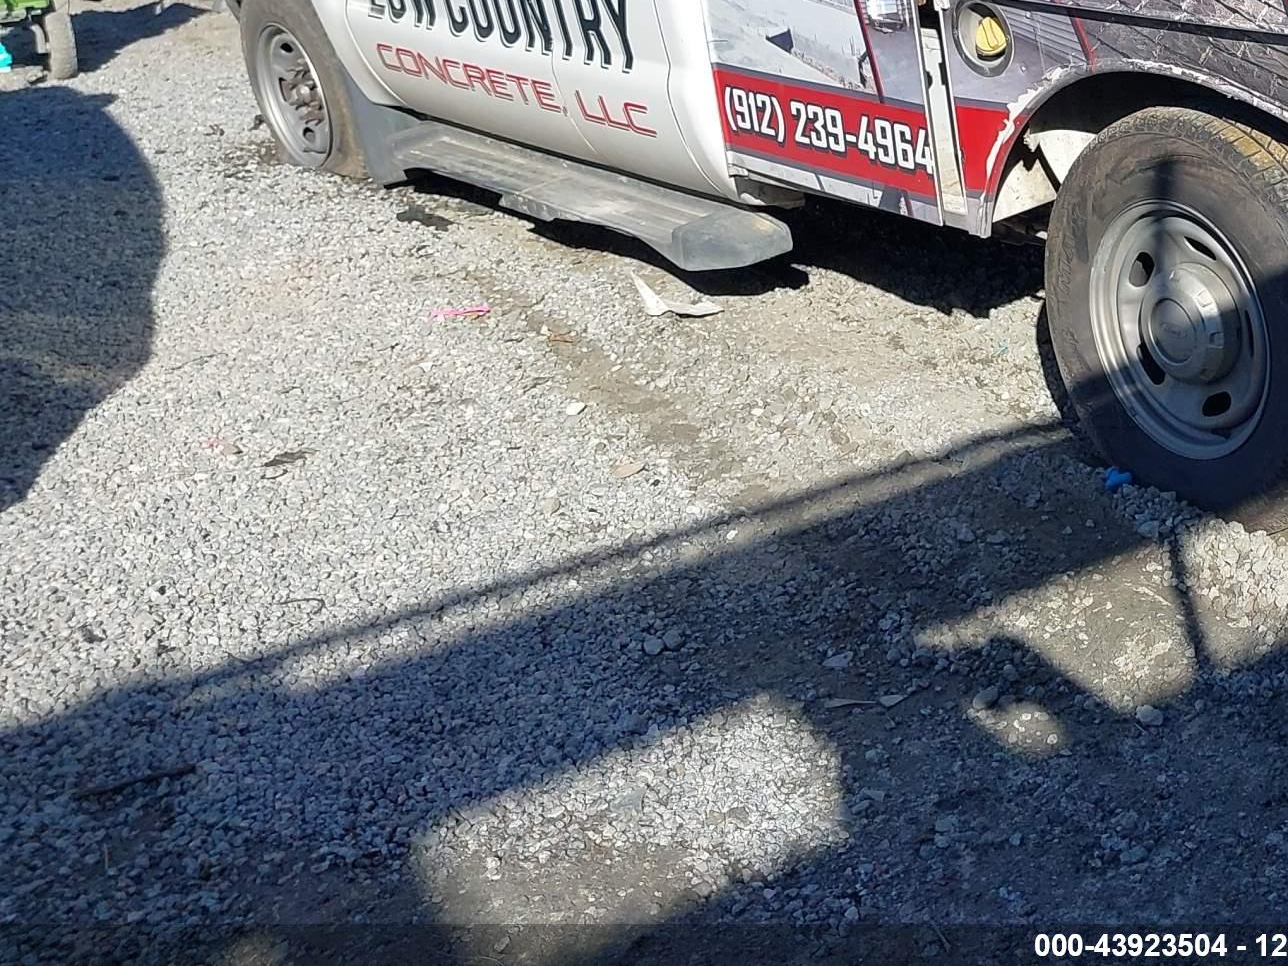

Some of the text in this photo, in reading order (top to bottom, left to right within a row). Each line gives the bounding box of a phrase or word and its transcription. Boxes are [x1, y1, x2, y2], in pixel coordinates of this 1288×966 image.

[376, 42, 658, 138] CONCRETE, LLC
[724, 86, 935, 175] (912) 239-4964
